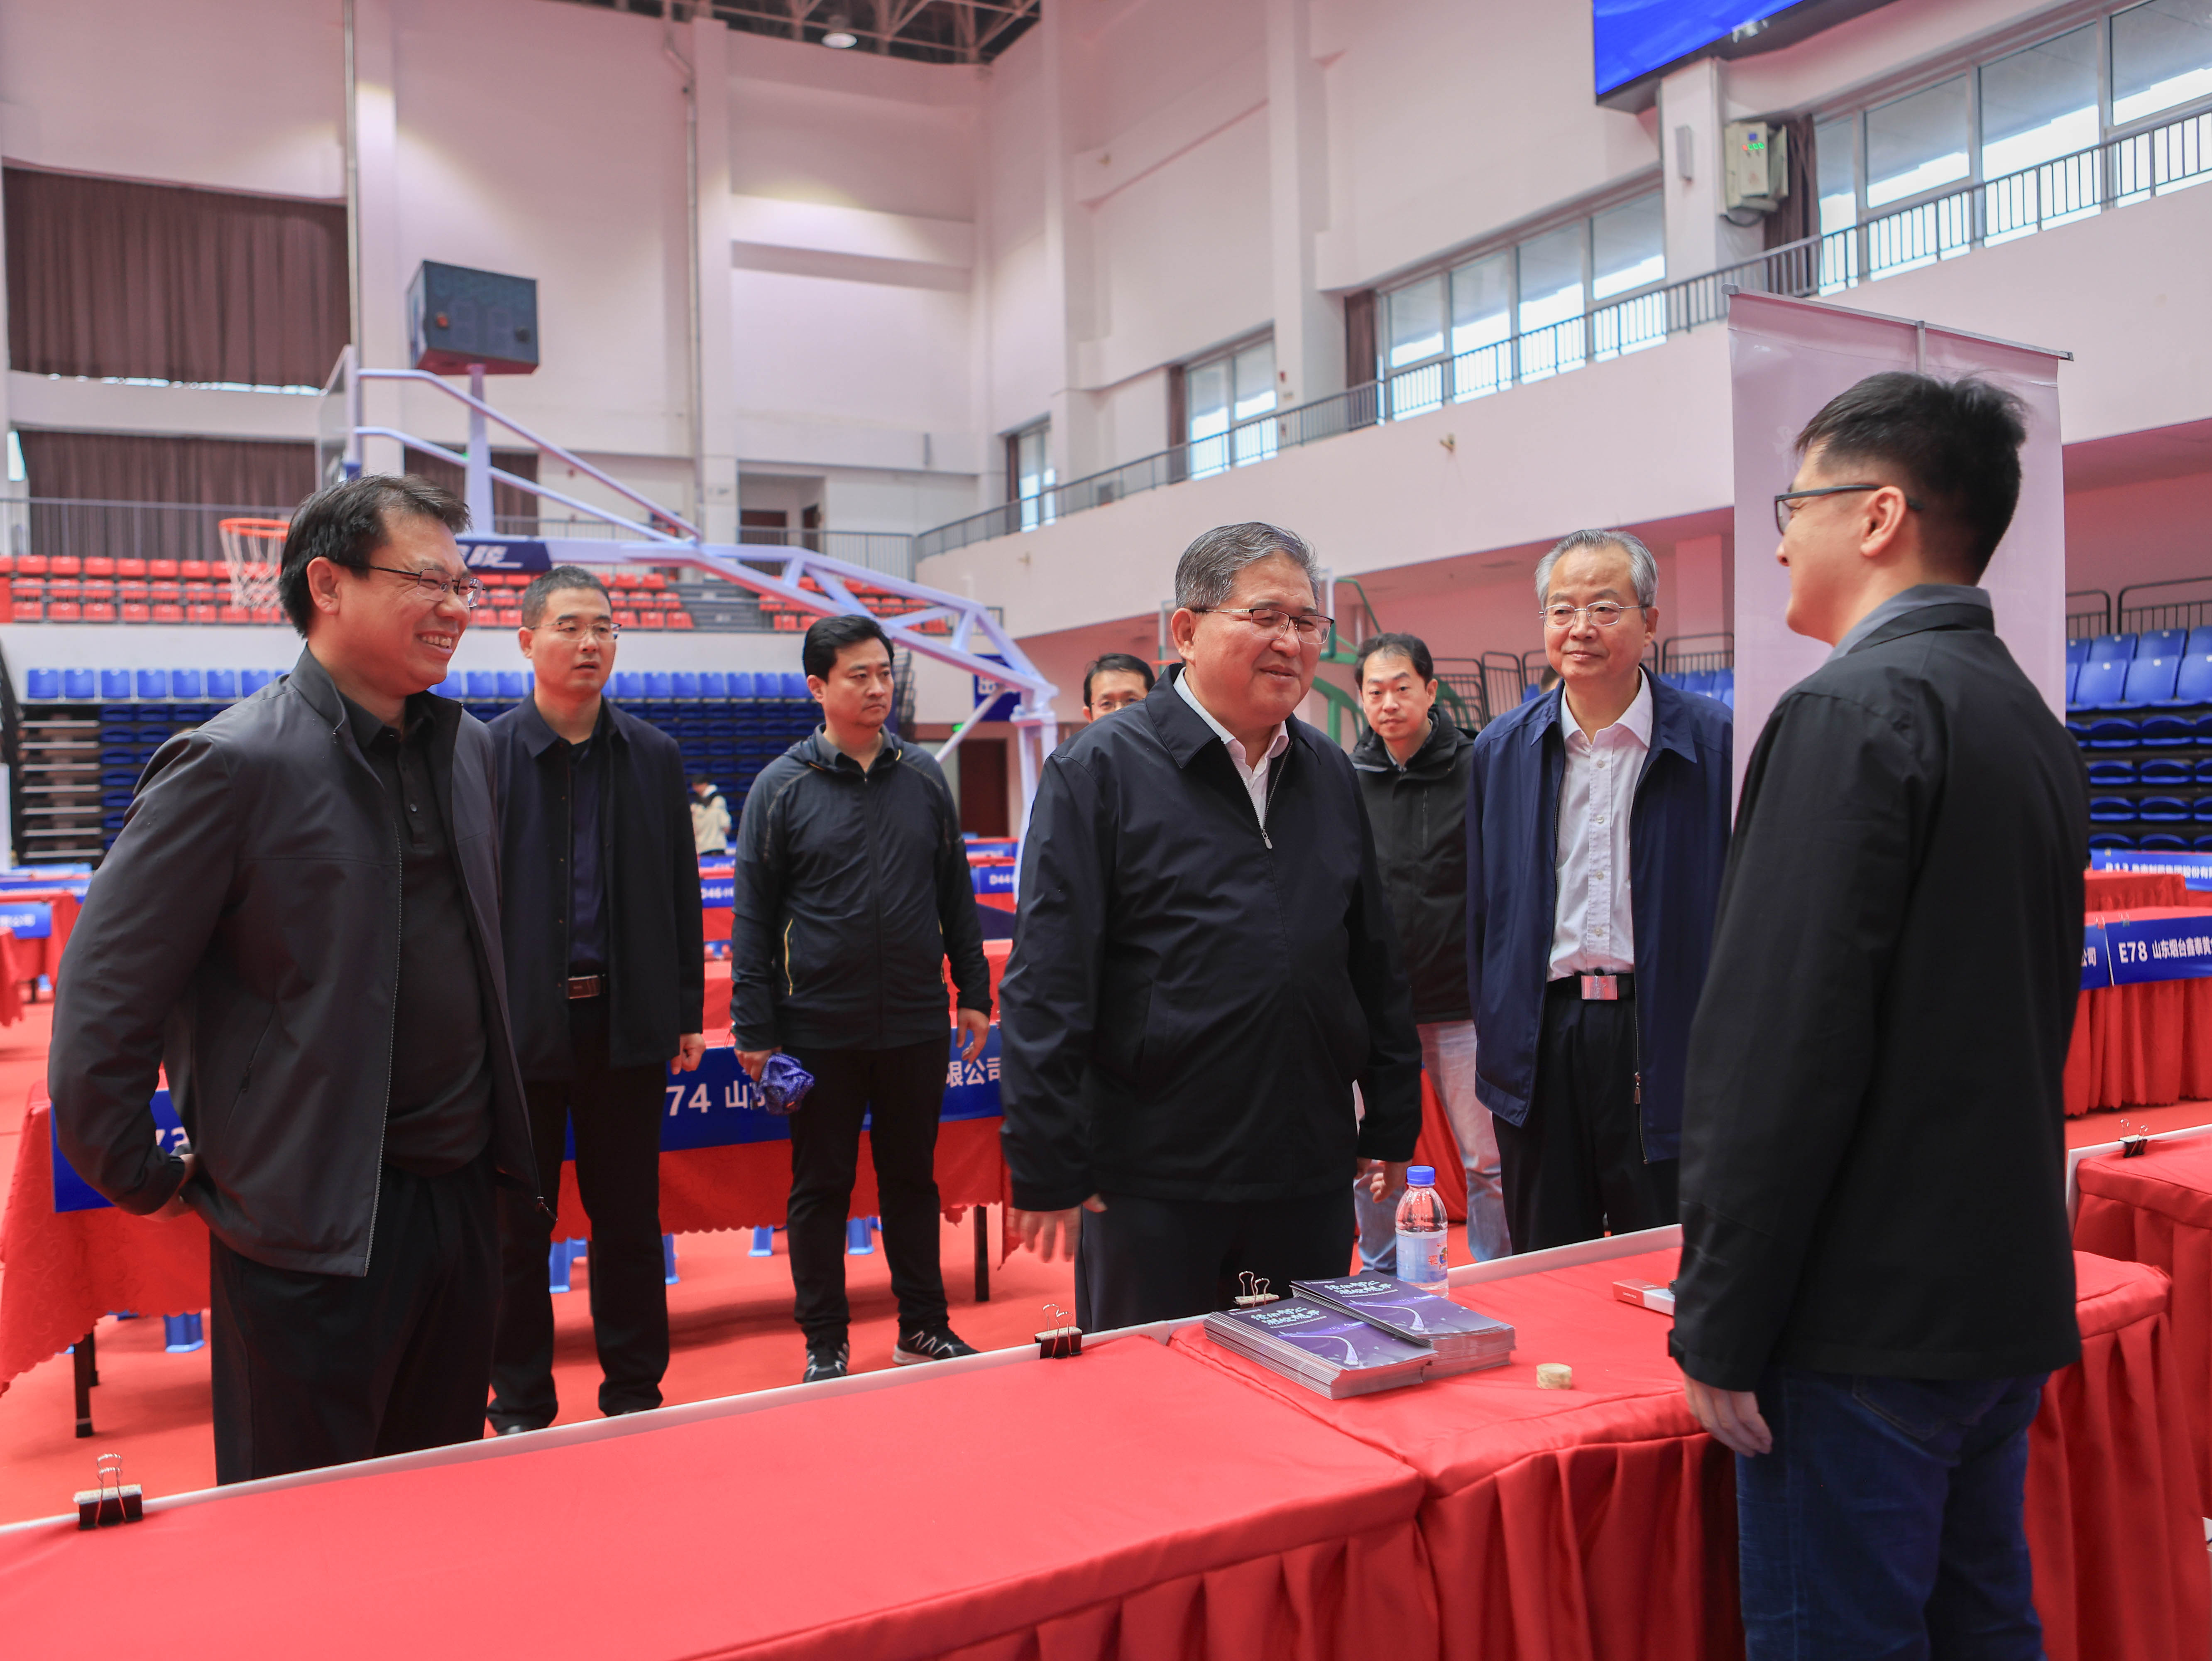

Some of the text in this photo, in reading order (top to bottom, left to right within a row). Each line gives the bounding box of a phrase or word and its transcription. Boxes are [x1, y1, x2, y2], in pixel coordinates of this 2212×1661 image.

[2118, 935, 2212, 963] E78 山东烟台鑫泰黄
[666, 1083, 712, 1117] 74
